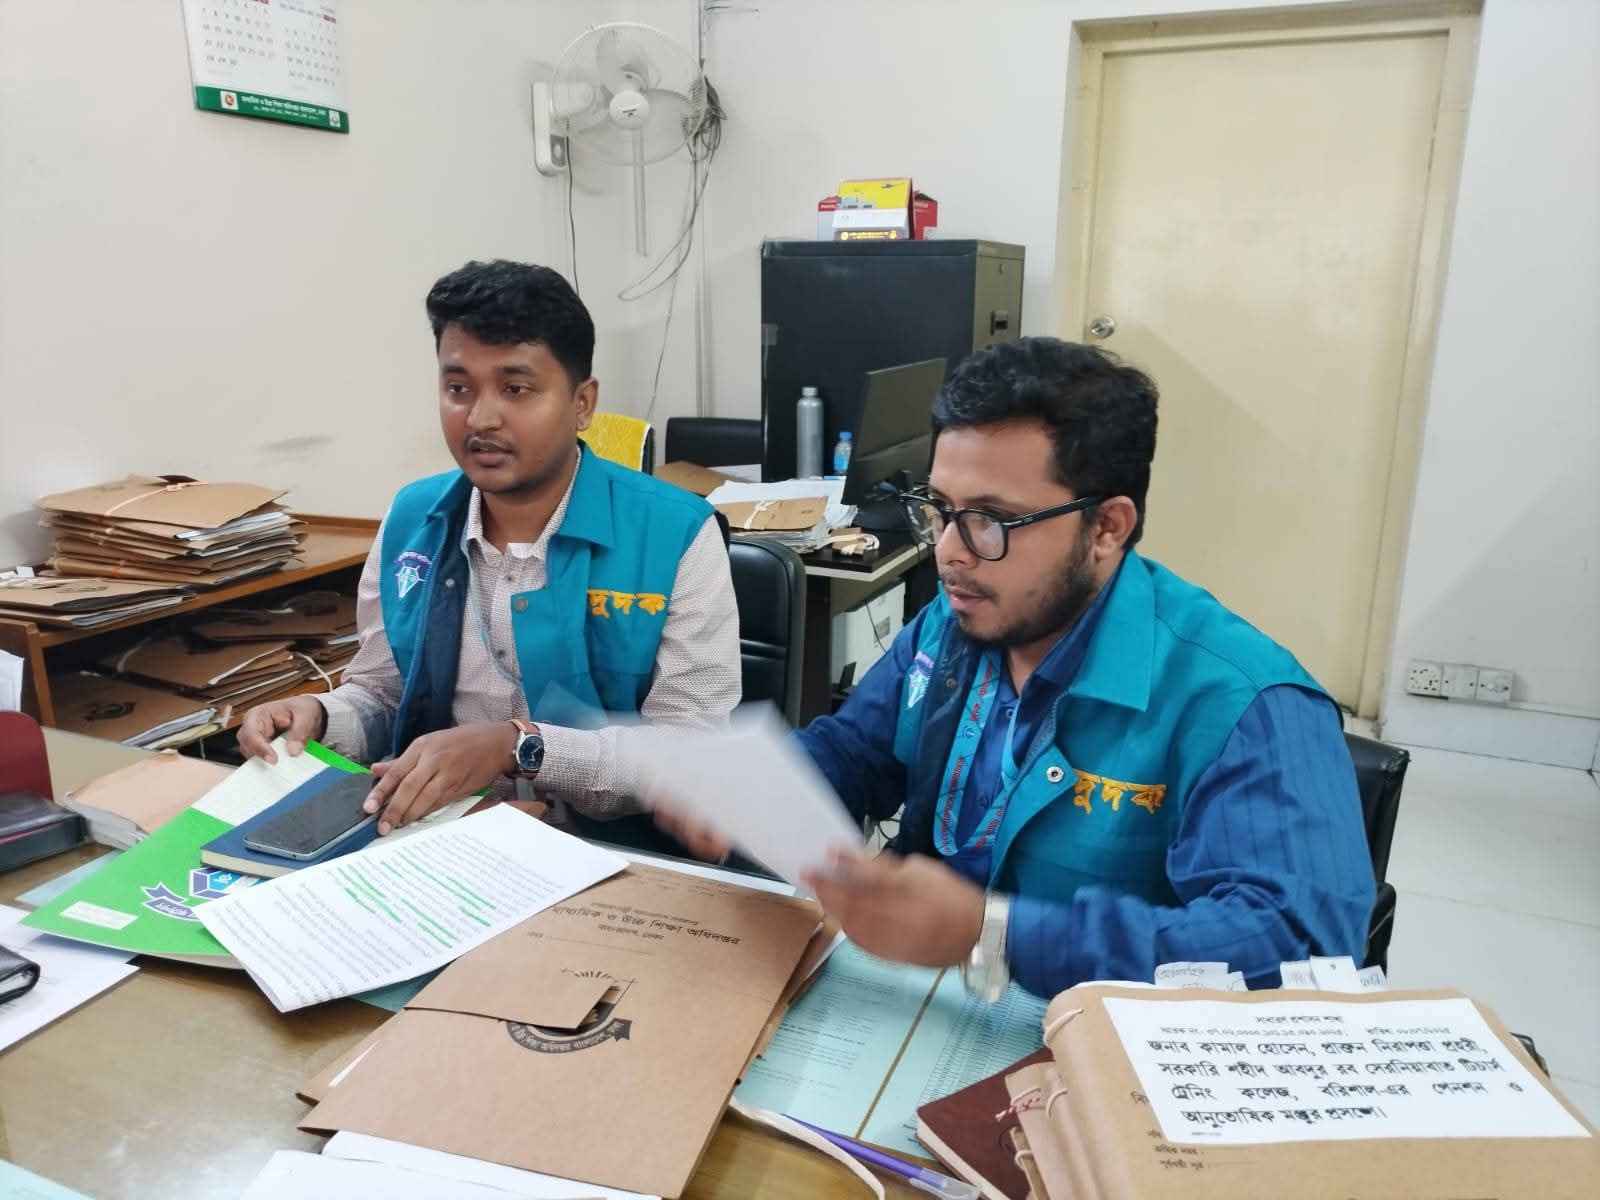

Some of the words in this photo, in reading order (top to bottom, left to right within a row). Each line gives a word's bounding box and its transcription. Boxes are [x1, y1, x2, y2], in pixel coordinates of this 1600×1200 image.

[587, 589, 668, 619] দুদক
[1072, 768, 1167, 815] দুদক
[607, 913, 617, 921] ও
[621, 914, 646, 927] উচ্চ
[648, 918, 683, 935] শিক্ষা
[687, 925, 743, 943] অধিদপ্তর
[1147, 1040, 1192, 1054] জনাব
[1197, 1041, 1249, 1055] কামাল
[1257, 1041, 1316, 1057] হোসেন,
[1320, 1041, 1368, 1056] প্রাক্তন
[1371, 1038, 1434, 1054] নিরাপত্তা
[1441, 1037, 1488, 1054] প্রহরী,
[1157, 1061, 1220, 1077] সরকারি
[1225, 1061, 1269, 1078] শহীদ
[1273, 1064, 1329, 1080] আবদুর
[1332, 1064, 1359, 1076] রব
[1365, 1059, 1455, 1075] সেরনিয়াবাত
[1458, 1057, 1506, 1072] টিচার্স
[1171, 1083, 1219, 1101] ট্রেনিং
[1236, 1086, 1299, 1101] কলেজ,
[1317, 1082, 1412, 1098] বরিশাল-এর
[1431, 1081, 1489, 1096] পেনশন
[1508, 1081, 1524, 1093] ও
[1181, 1106, 1275, 1128] আনুতোষিক
[1278, 1108, 1323, 1125] মঞ্জুর
